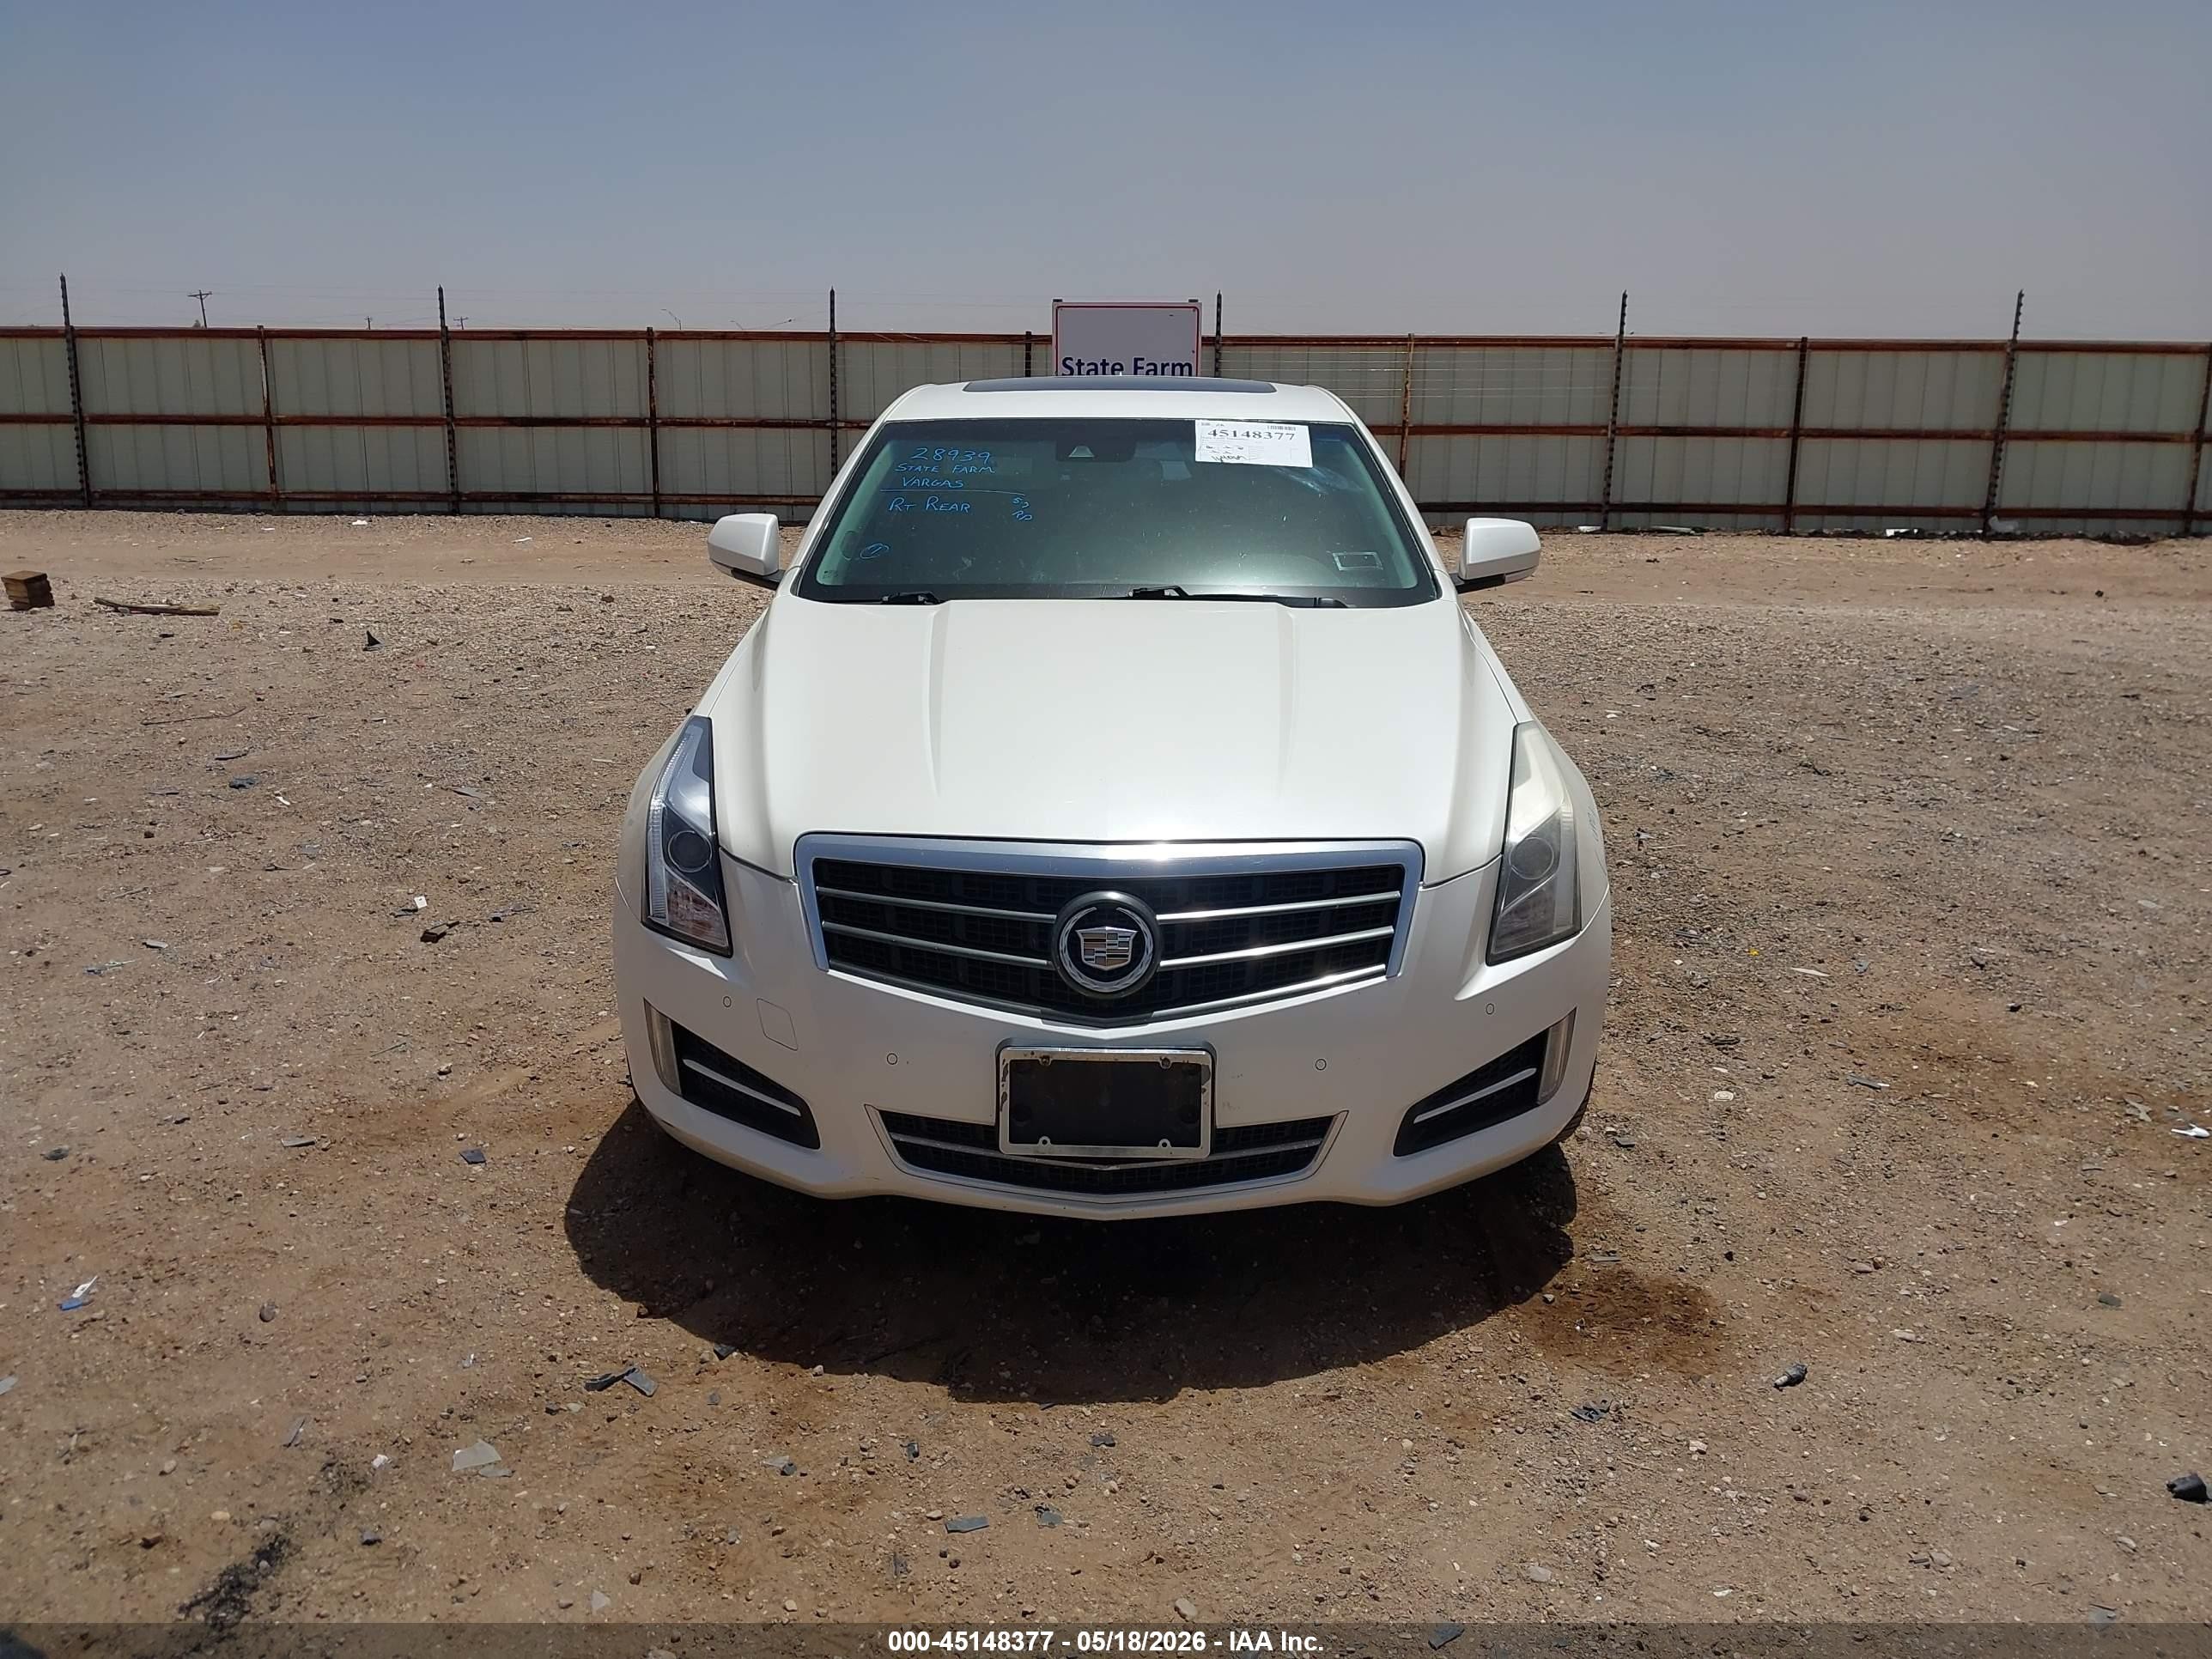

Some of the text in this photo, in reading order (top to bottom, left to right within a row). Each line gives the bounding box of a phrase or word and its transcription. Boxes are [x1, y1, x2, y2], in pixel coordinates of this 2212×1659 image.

[1061, 357, 1193, 375] State Farm
[1207, 428, 1295, 441] 45148377
[910, 447, 990, 465] 28939
[895, 463, 995, 473] STATE FARM
[902, 476, 963, 488] VARGAS
